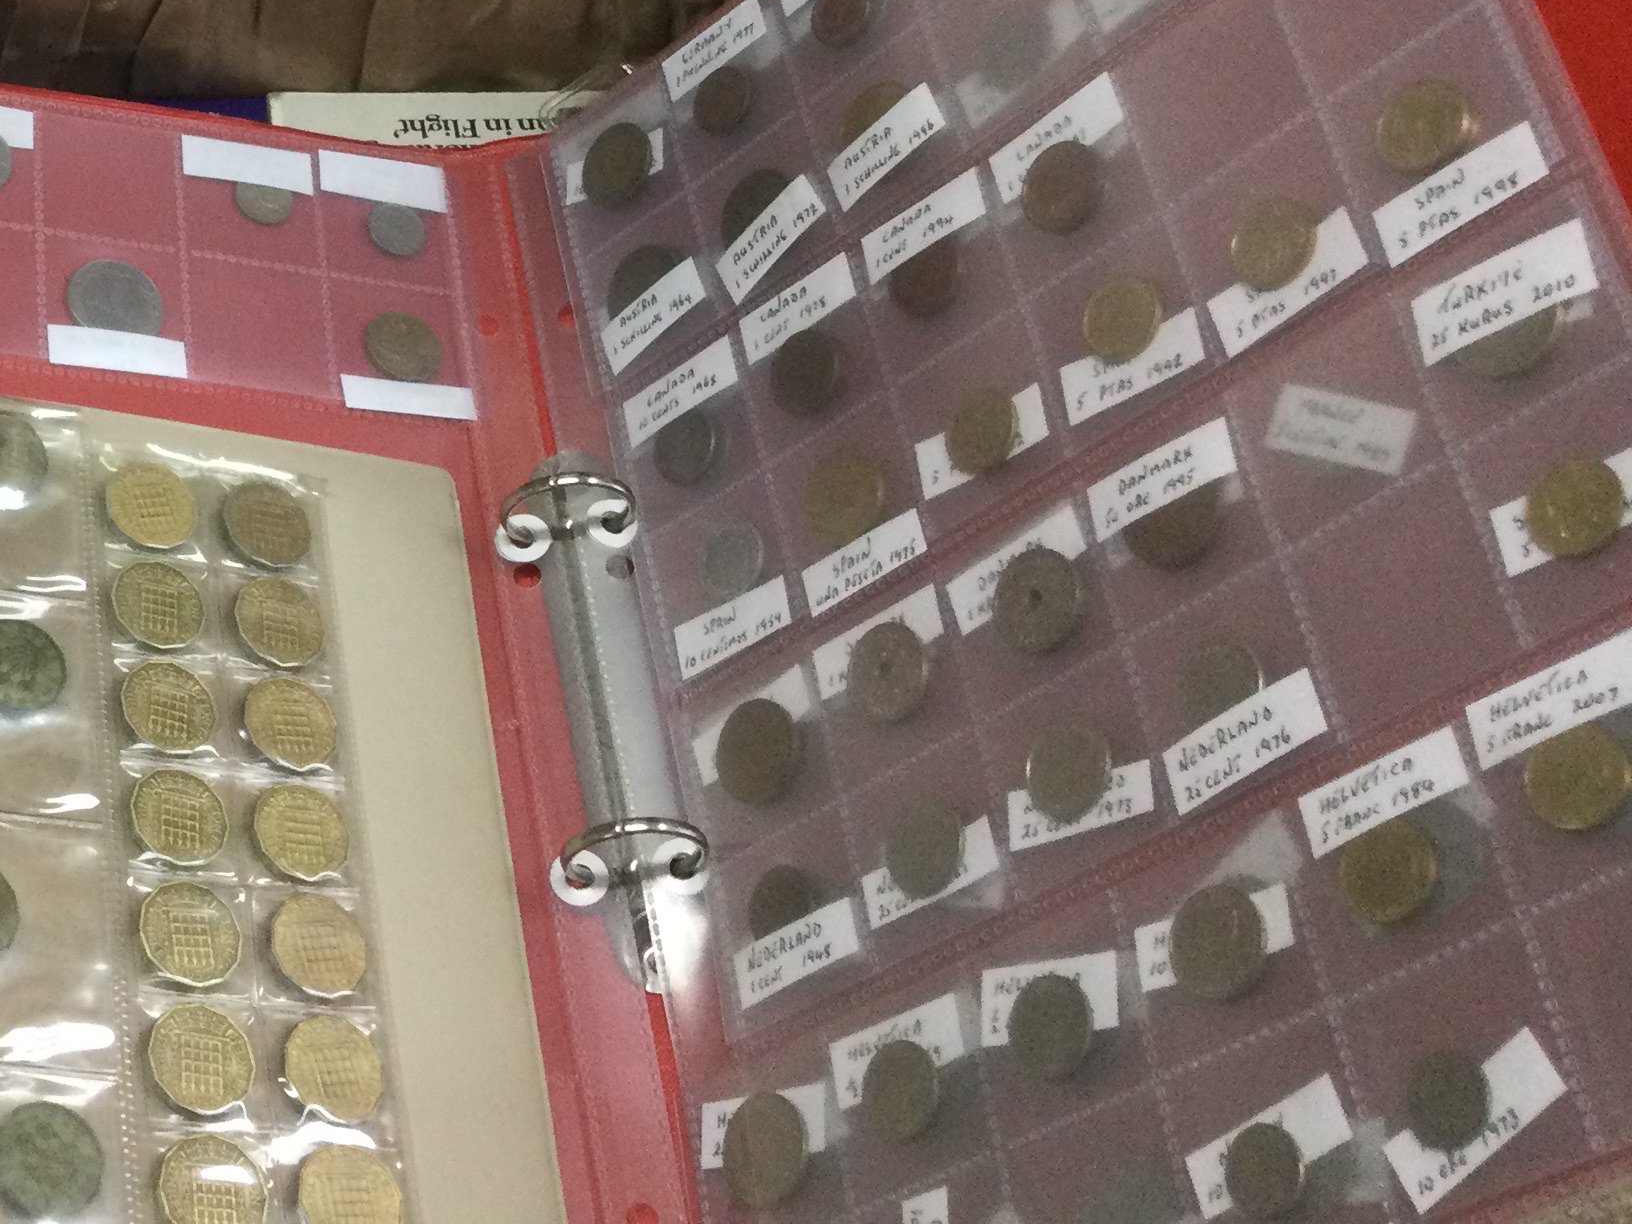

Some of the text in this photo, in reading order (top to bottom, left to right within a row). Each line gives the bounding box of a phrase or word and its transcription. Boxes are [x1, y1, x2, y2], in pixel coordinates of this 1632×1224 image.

[483, 117, 511, 137] in
[843, 124, 892, 170] AUSTRIA
[1414, 166, 1466, 210] SPAIN
[733, 214, 778, 265] AUSTRIA
[881, 202, 932, 243] CANADA
[1397, 231, 1409, 248] 5
[618, 292, 658, 328] AUSTRIA
[759, 284, 808, 323] CANADA
[1429, 327, 1450, 349] 25
[1530, 271, 1576, 302] 2010
[645, 367, 695, 407] CANADA
[1116, 444, 1192, 496] DANMARK
[831, 538, 874, 578] SPAIN
[702, 606, 738, 636] SPAIN
[683, 655, 696, 669] 10
[1177, 704, 1273, 772] NEDERLAND
[1317, 753, 1413, 815] HELVETICA
[744, 917, 822, 972] NEDERLAND
